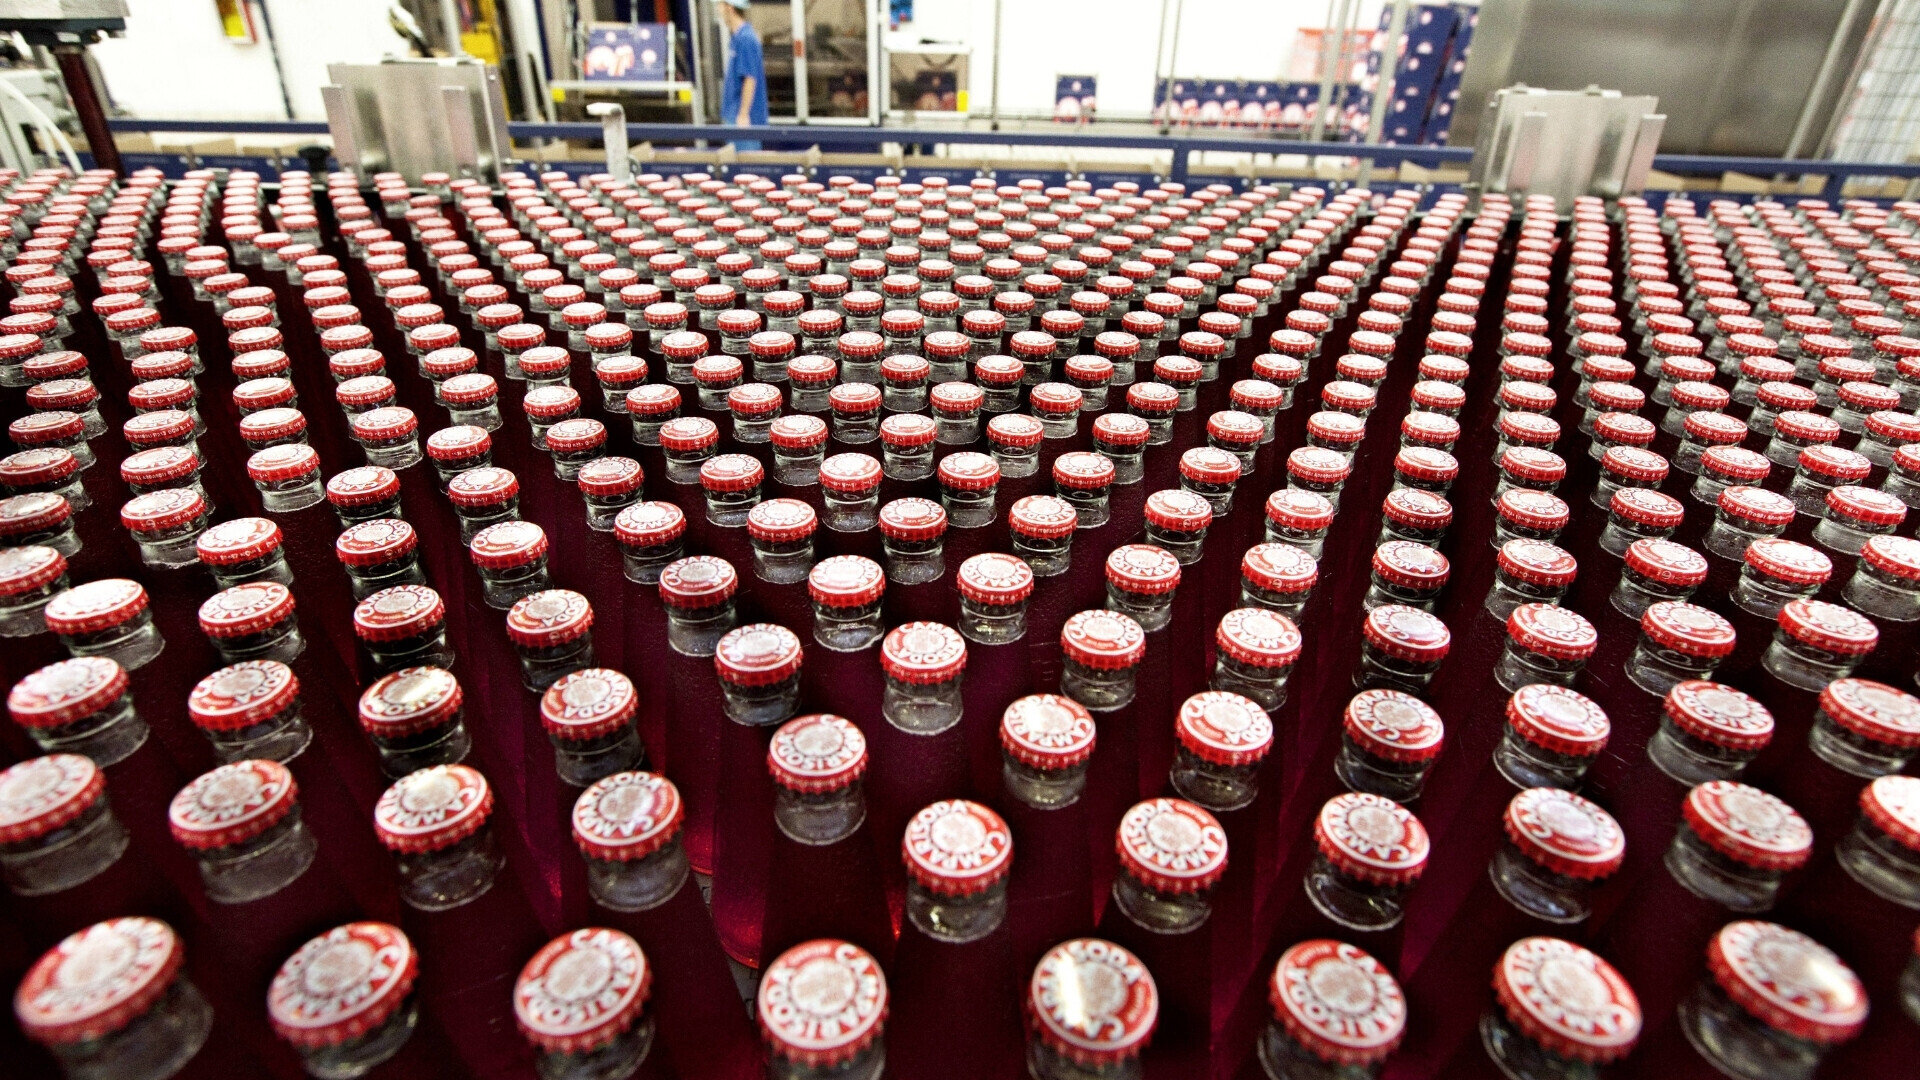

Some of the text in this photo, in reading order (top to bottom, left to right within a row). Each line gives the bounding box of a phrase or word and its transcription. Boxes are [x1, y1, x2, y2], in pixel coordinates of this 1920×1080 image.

[665, 555, 731, 586] CAMPARISODA
[1071, 609, 1140, 648] CAMPARISODA
[553, 669, 633, 718] CAMPARISODA
[777, 714, 862, 769] CAMPARISODA
[910, 800, 1006, 870] CAMPARISODA
[1125, 799, 1222, 871] CAMPARISODA
[1325, 794, 1411, 861] CAMPARISODA
[766, 942, 881, 1039] CAMPARISODA
[1284, 942, 1401, 1040] CAMPARISODA
